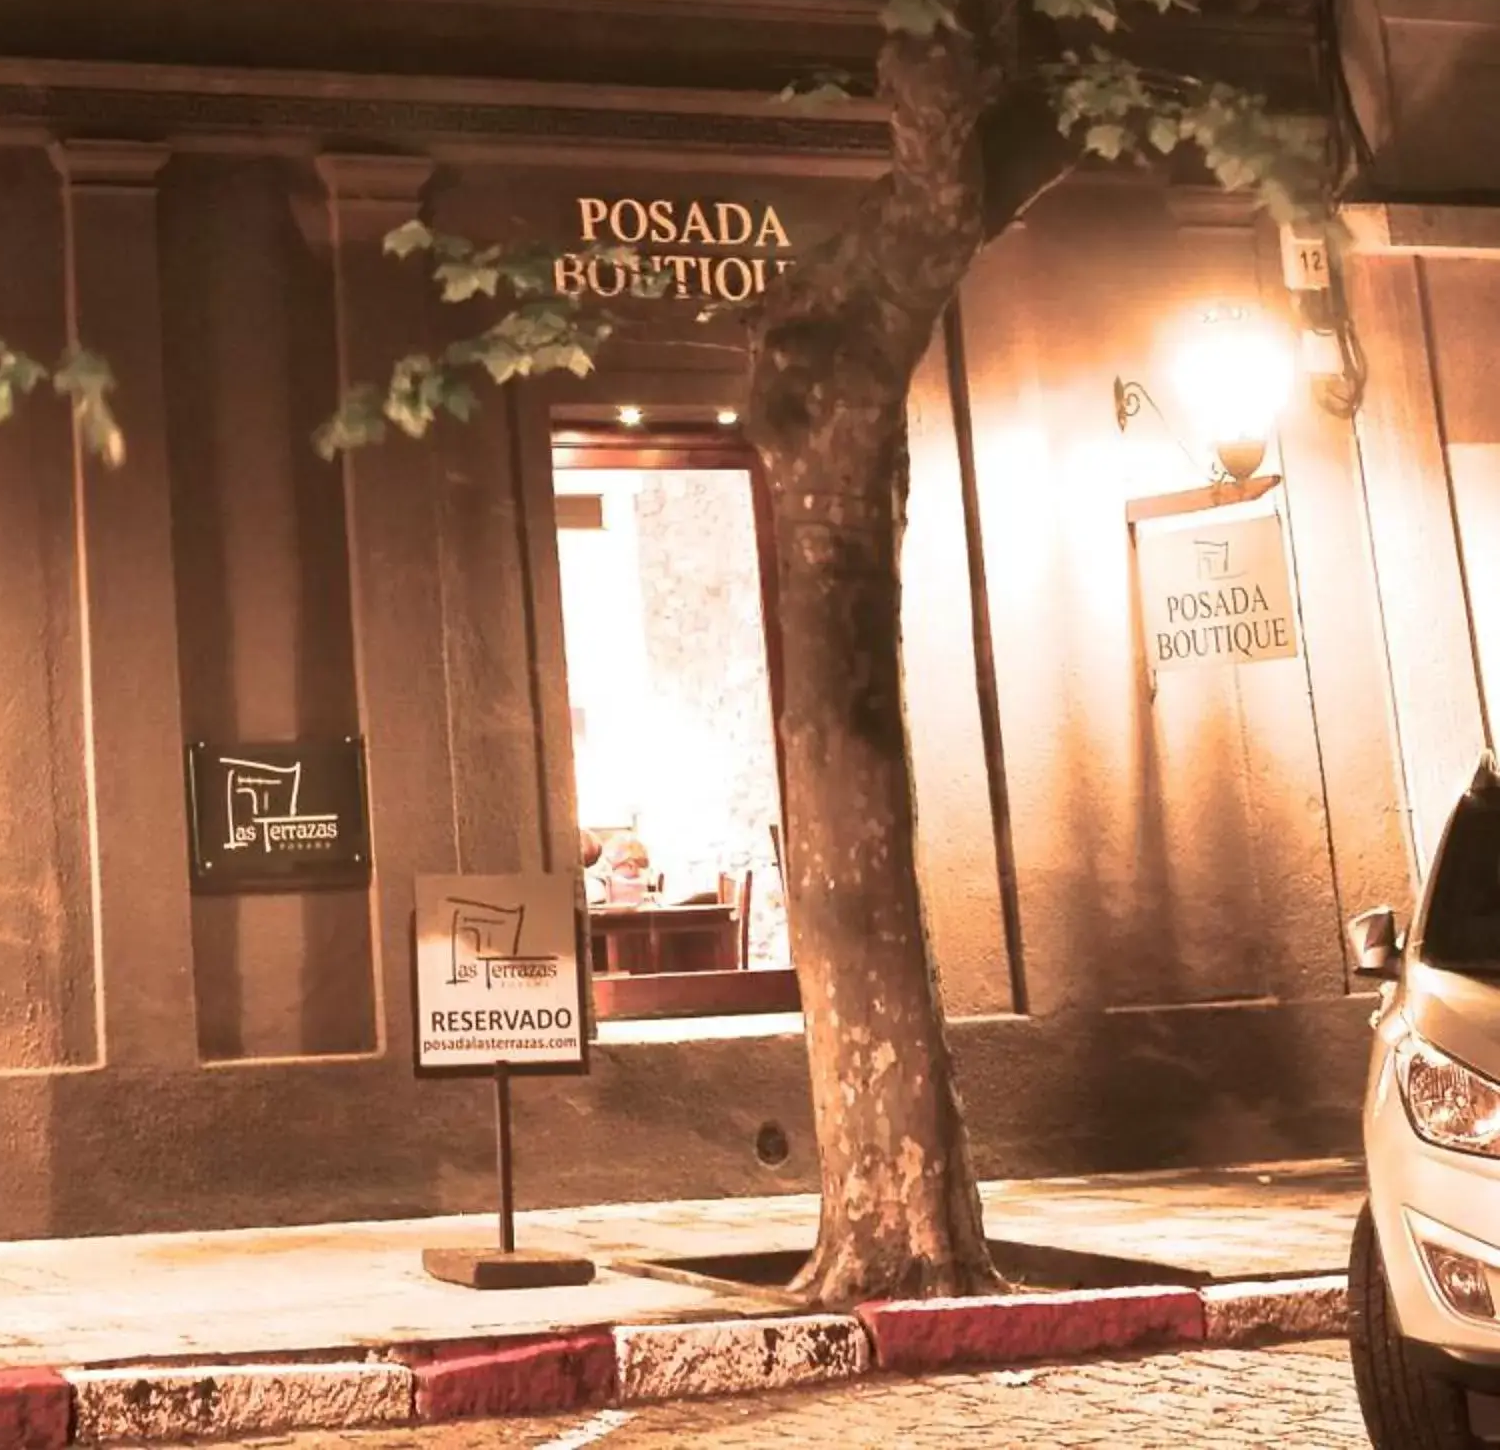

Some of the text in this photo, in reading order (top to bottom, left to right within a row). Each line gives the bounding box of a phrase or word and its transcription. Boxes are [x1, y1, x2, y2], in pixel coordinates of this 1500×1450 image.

[577, 198, 792, 247] POSADA
[1300, 250, 1323, 271] 12
[1167, 584, 1268, 623] POSADA
[1156, 618, 1288, 660] BOUTIQUE
[253, 815, 338, 852] Terrazas
[476, 956, 558, 990] Terrazas
[431, 1008, 572, 1033] RESERVADO
[423, 1036, 577, 1053] posadalasterrazas.com
